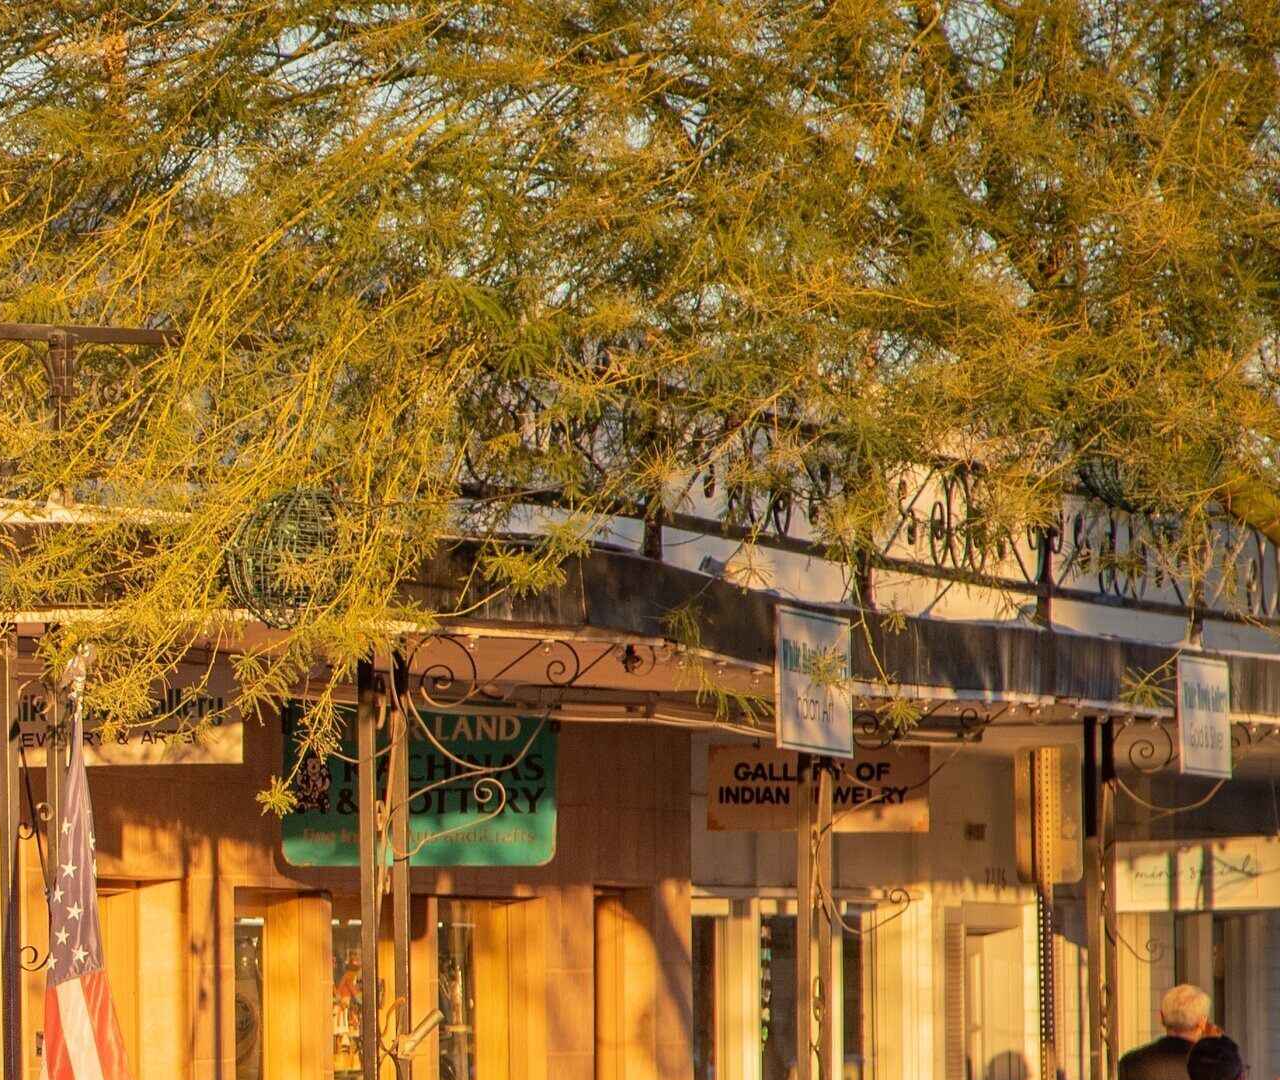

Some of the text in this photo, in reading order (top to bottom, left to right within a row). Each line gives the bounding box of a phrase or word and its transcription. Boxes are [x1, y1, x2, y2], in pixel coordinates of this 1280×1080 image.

[137, 688, 224, 727] allery
[116, 730, 129, 745] &
[440, 714, 522, 741] LAND
[733, 762, 891, 782] GALLRY OF
[336, 785, 546, 815] & OTTERY
[719, 786, 790, 804] INDIAN
